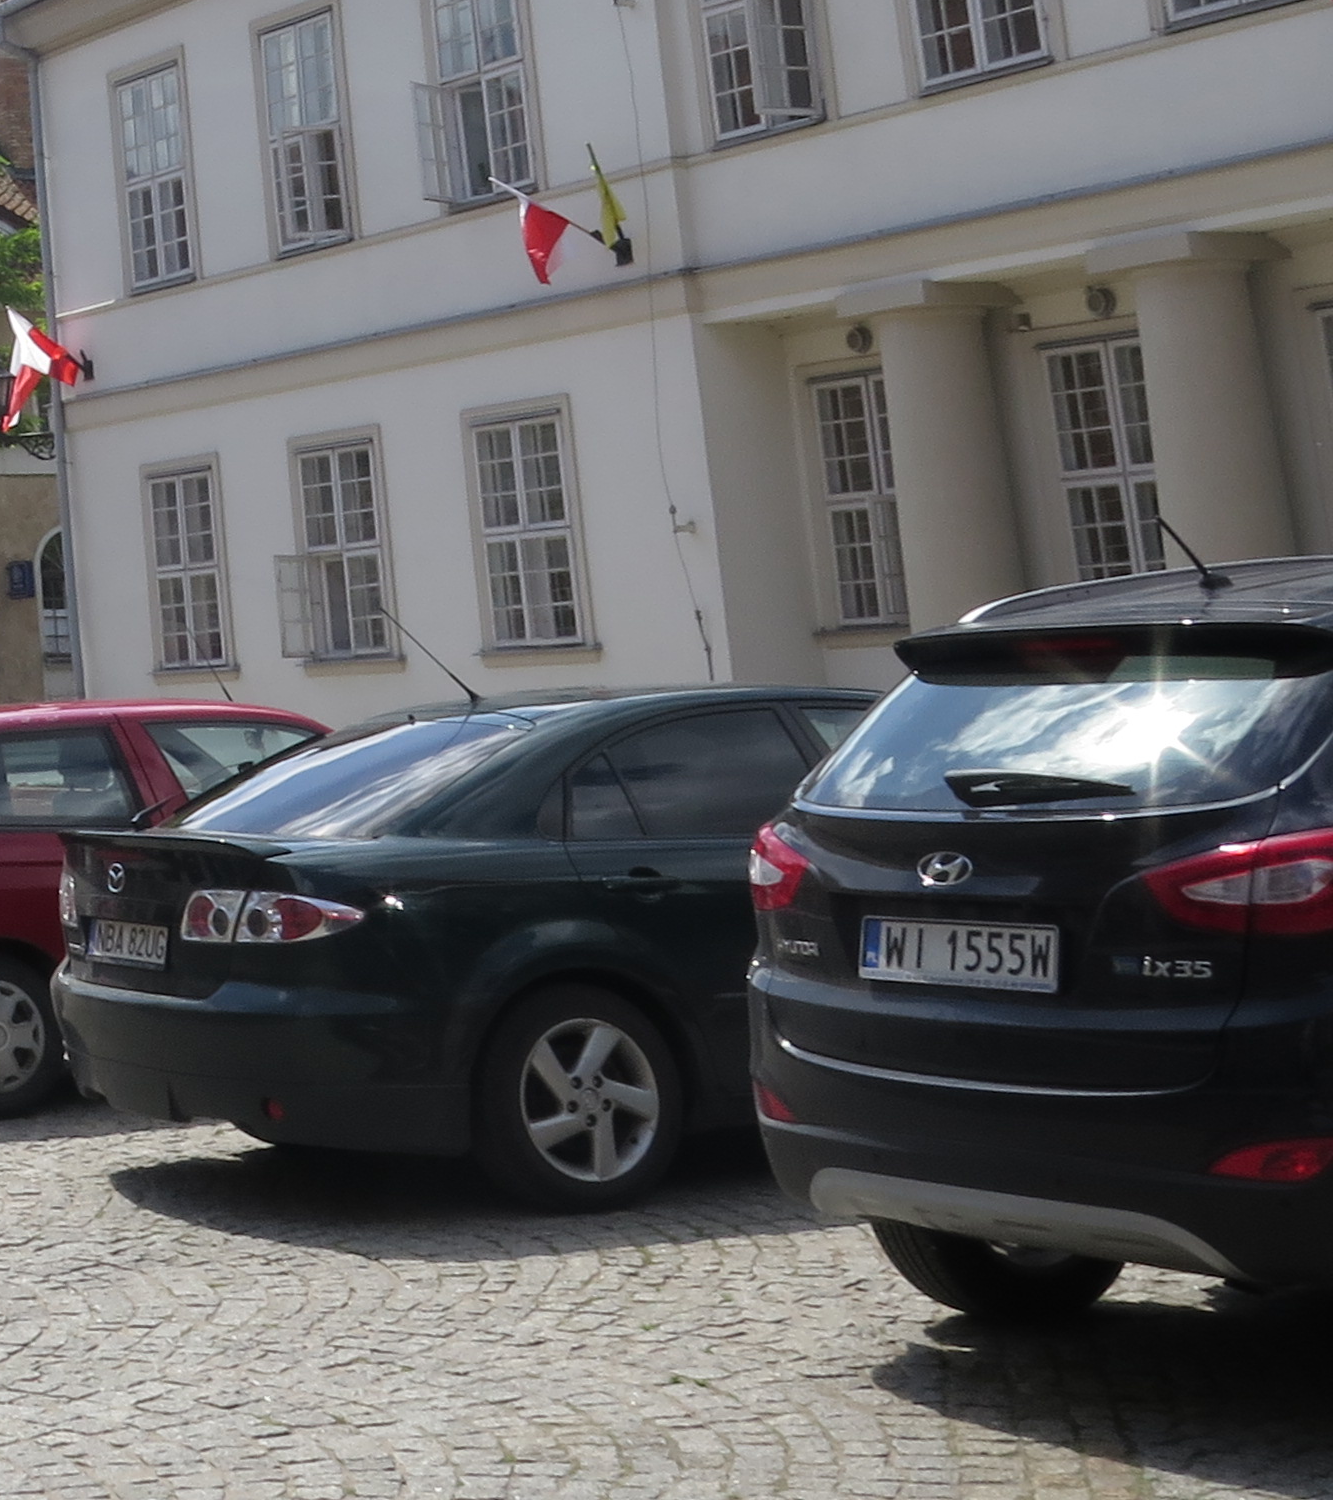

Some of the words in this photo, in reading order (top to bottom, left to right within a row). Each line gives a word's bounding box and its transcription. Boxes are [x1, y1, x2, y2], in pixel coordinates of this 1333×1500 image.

[97, 922, 123, 955] NBA
[128, 927, 165, 959] 82UG
[886, 926, 924, 969] WI
[946, 930, 1052, 978] 1555W
[1141, 955, 1213, 978] ix35
